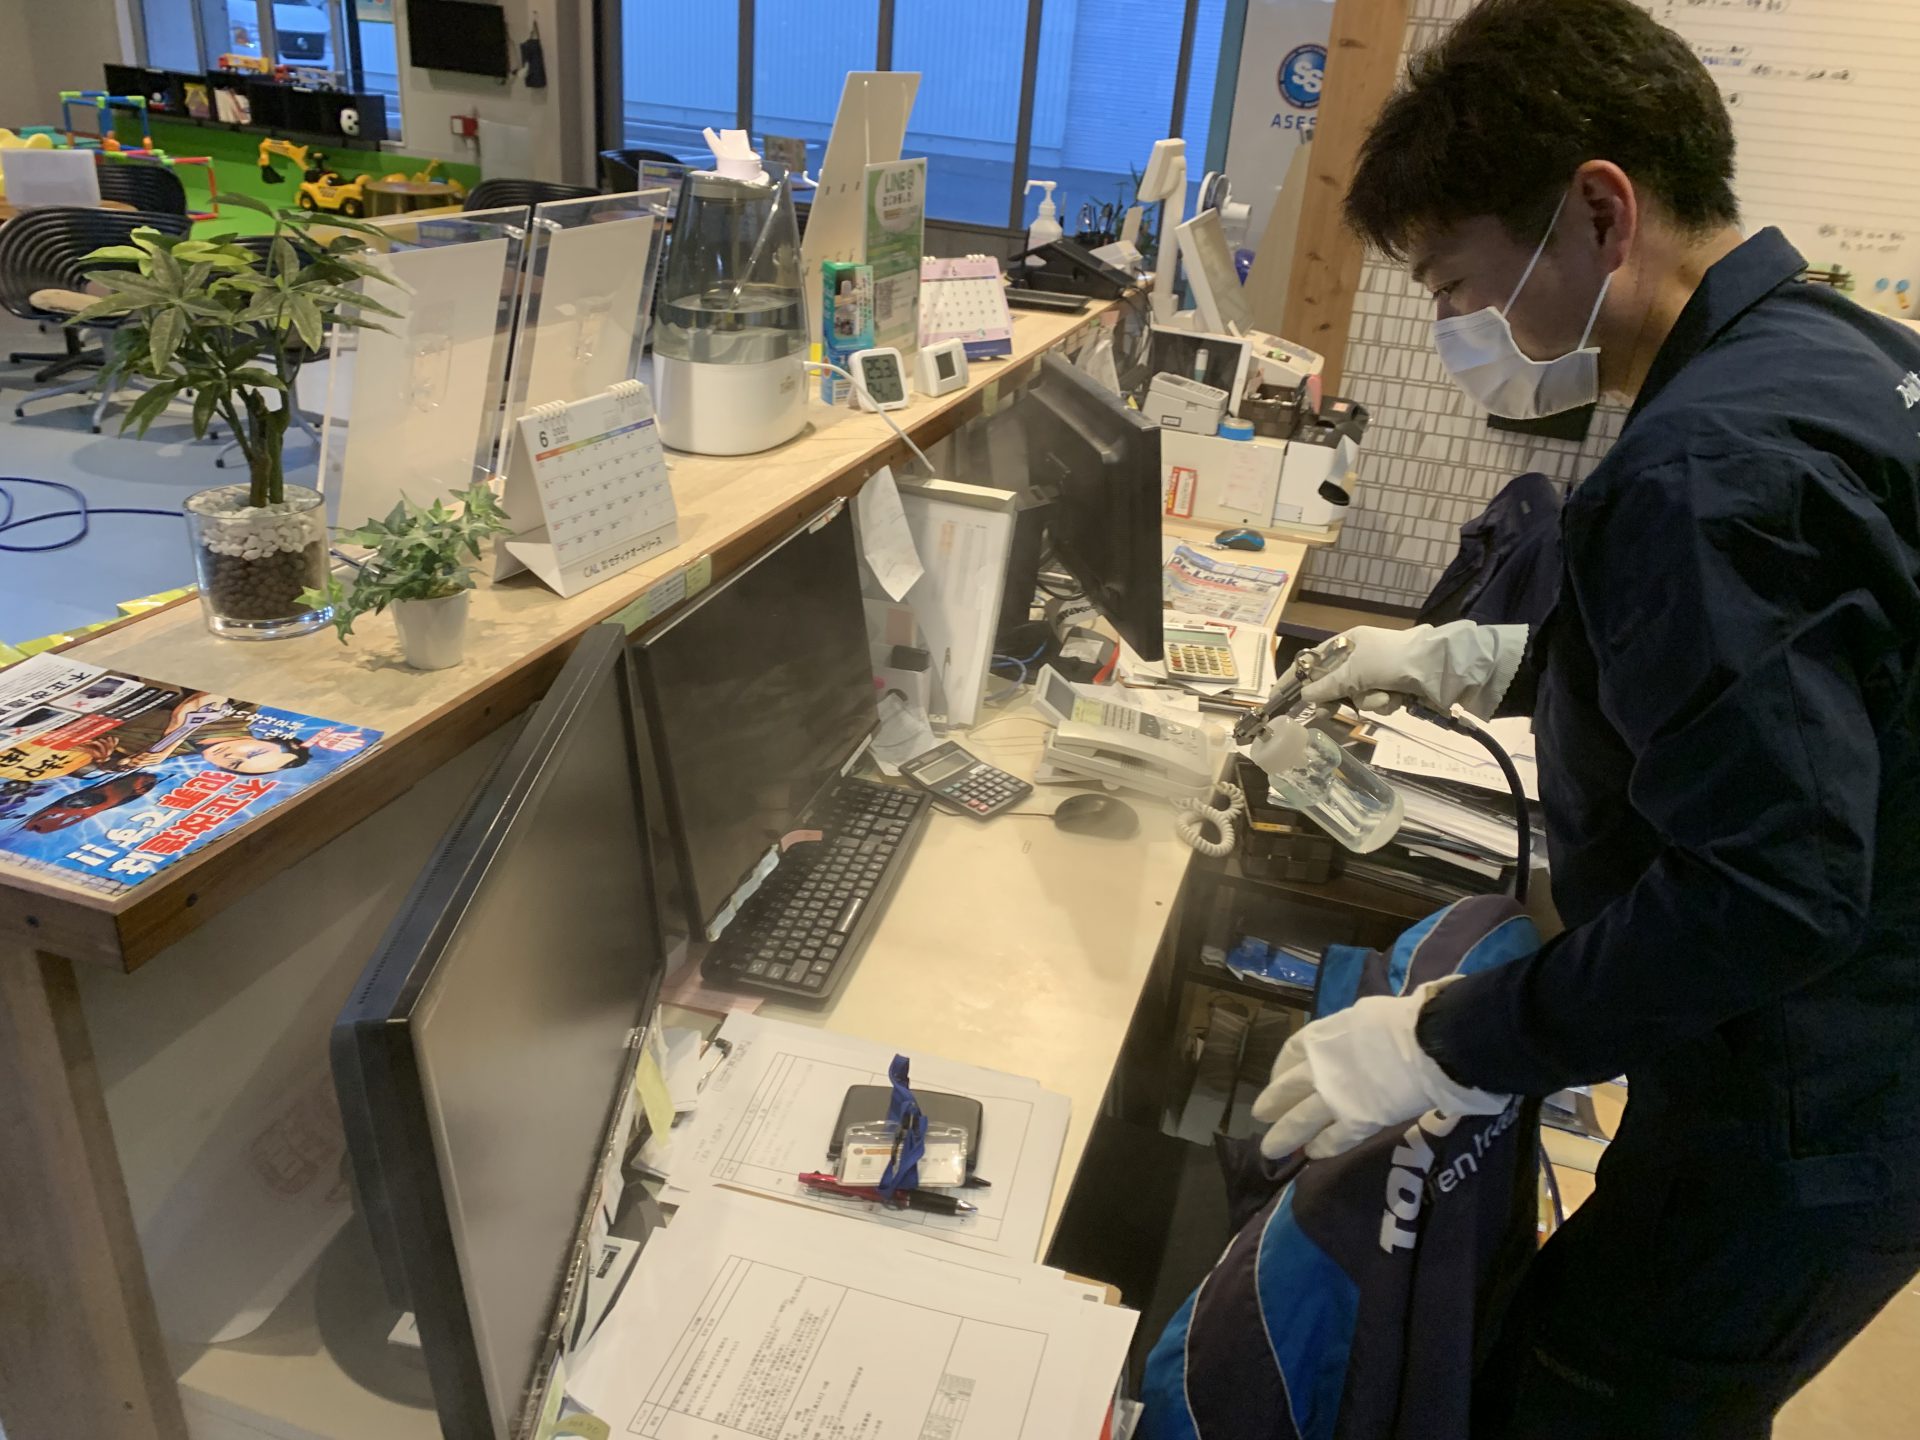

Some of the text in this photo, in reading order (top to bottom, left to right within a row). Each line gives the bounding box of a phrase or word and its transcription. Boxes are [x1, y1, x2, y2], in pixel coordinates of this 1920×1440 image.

[539, 431, 549, 448] 6
[108, 778, 280, 875] 不正改造は
